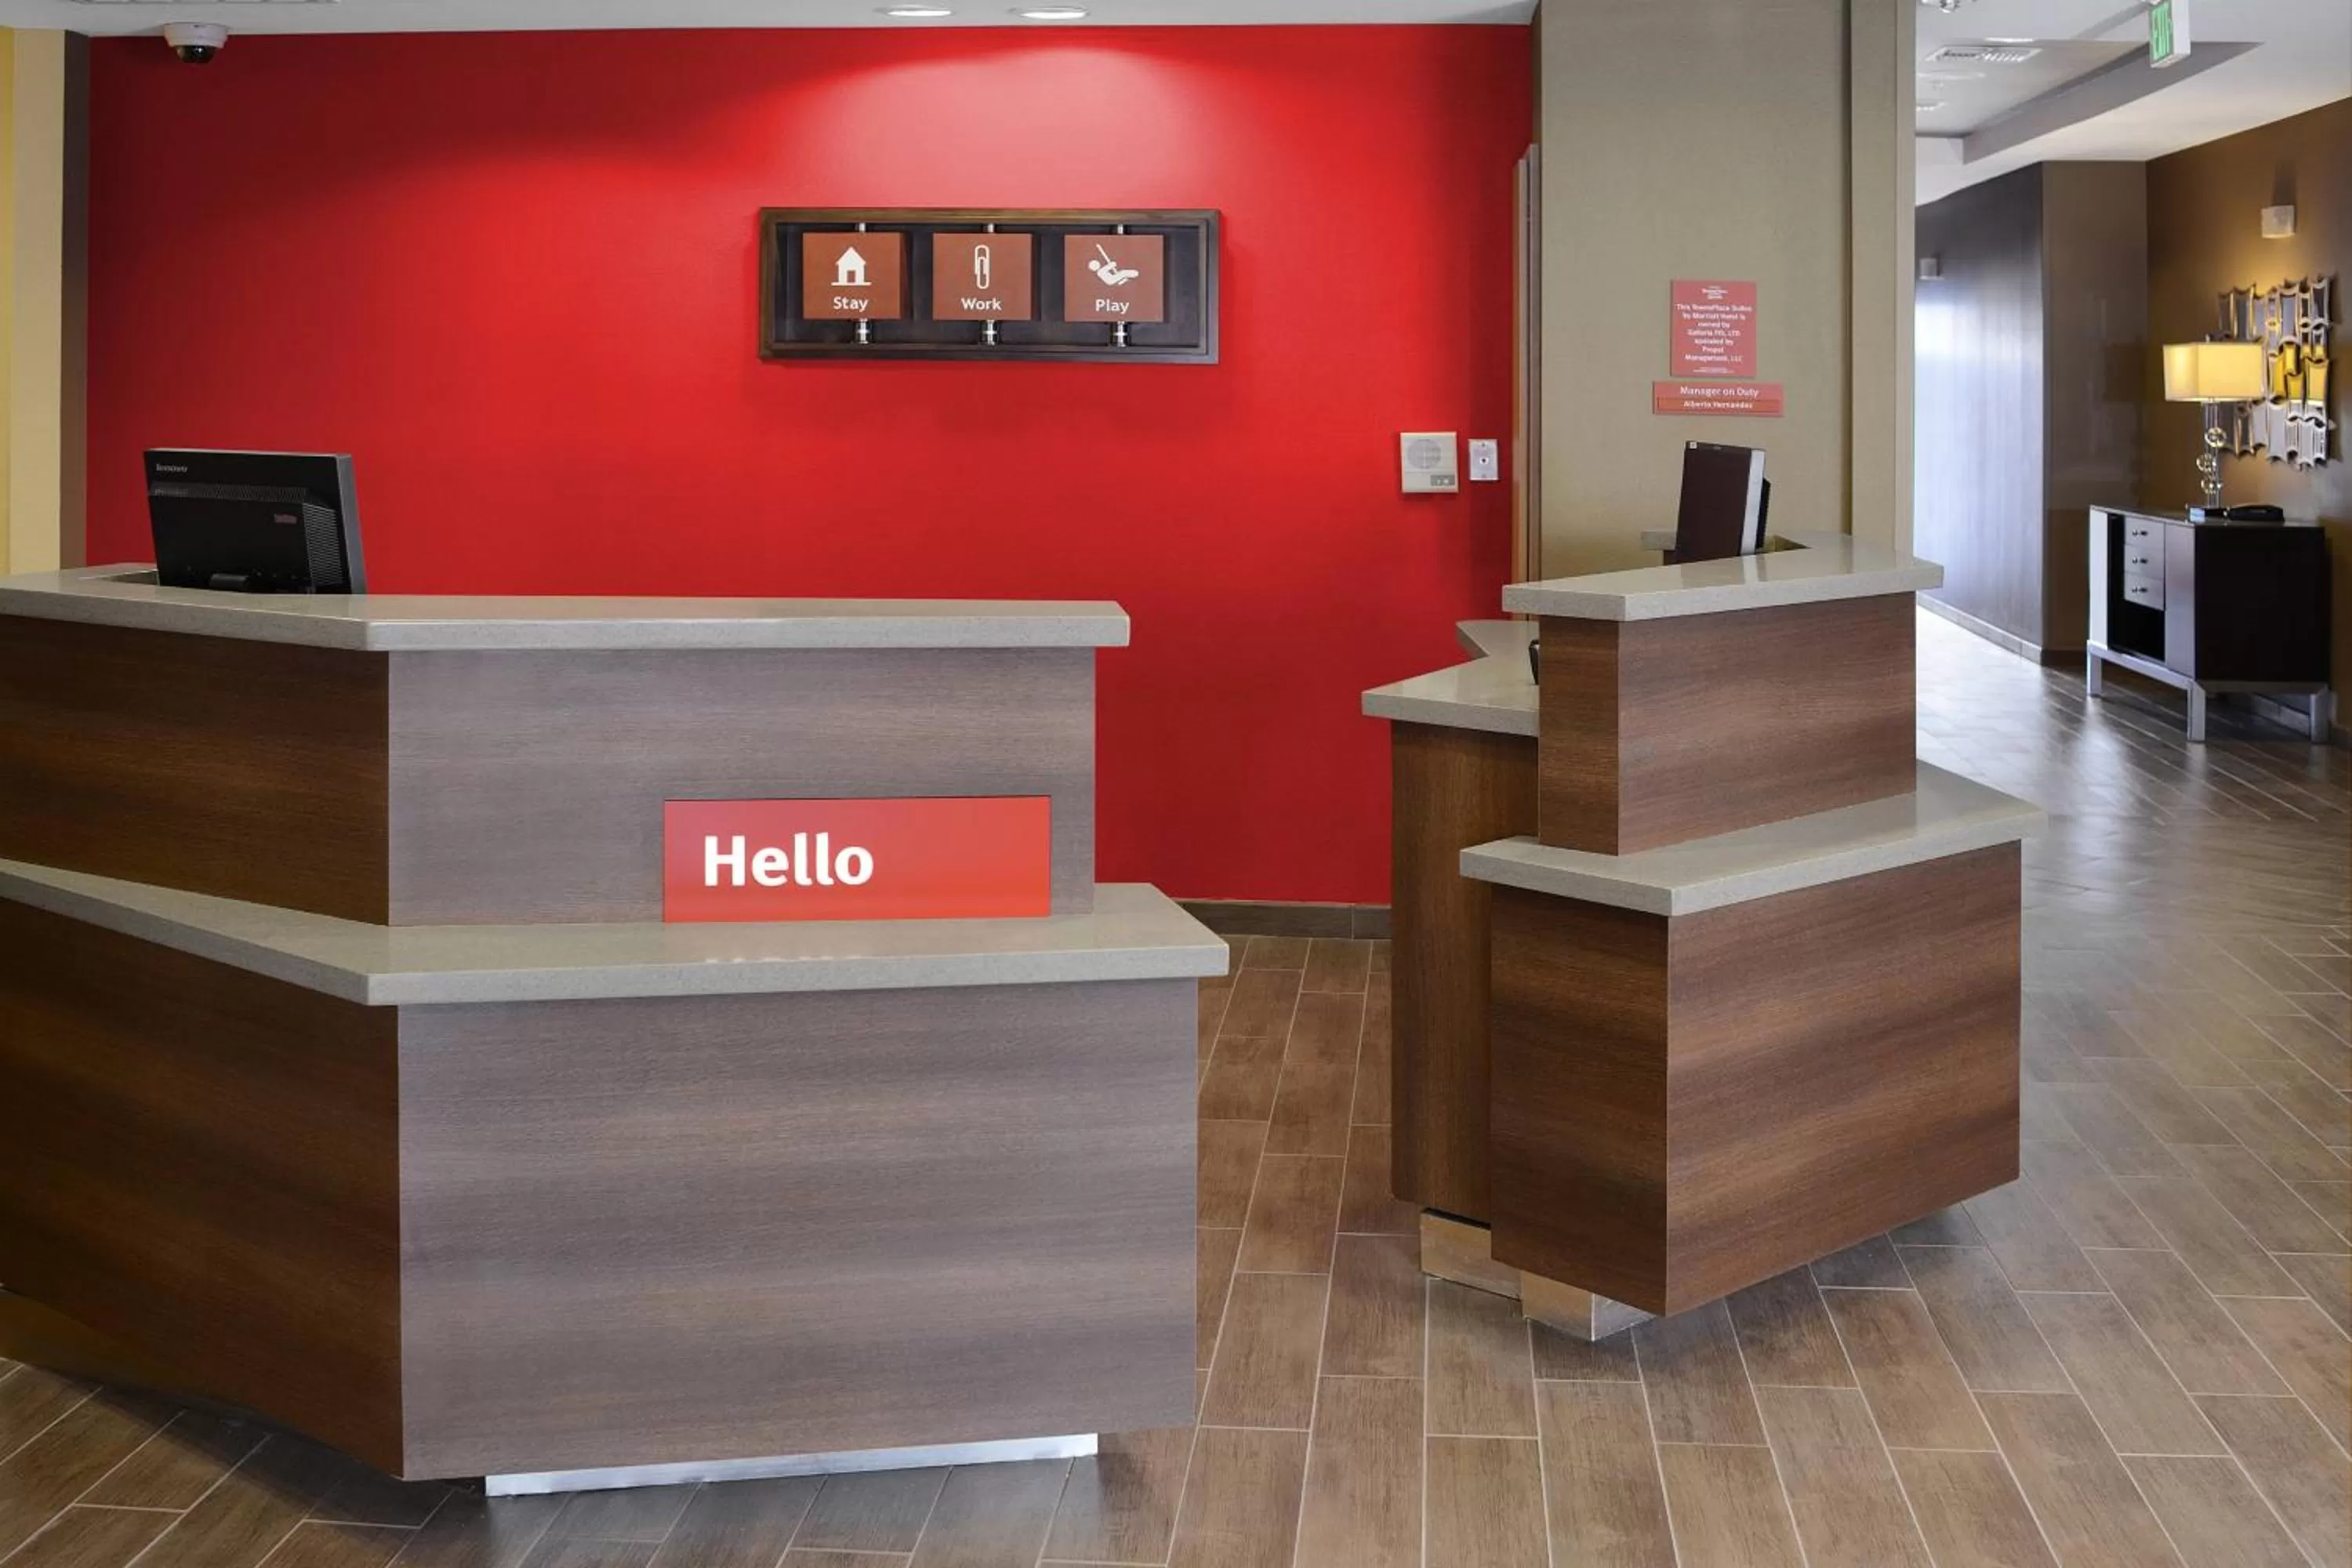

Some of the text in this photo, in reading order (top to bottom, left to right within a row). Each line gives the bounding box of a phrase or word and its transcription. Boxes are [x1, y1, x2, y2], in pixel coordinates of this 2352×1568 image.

[833, 296, 869, 313] Stay
[961, 296, 1002, 312] Work
[1095, 299, 1130, 314] Play
[1680, 385, 1759, 398] Manager on Duty
[156, 463, 188, 473] lenovo
[704, 832, 874, 887] Hello
